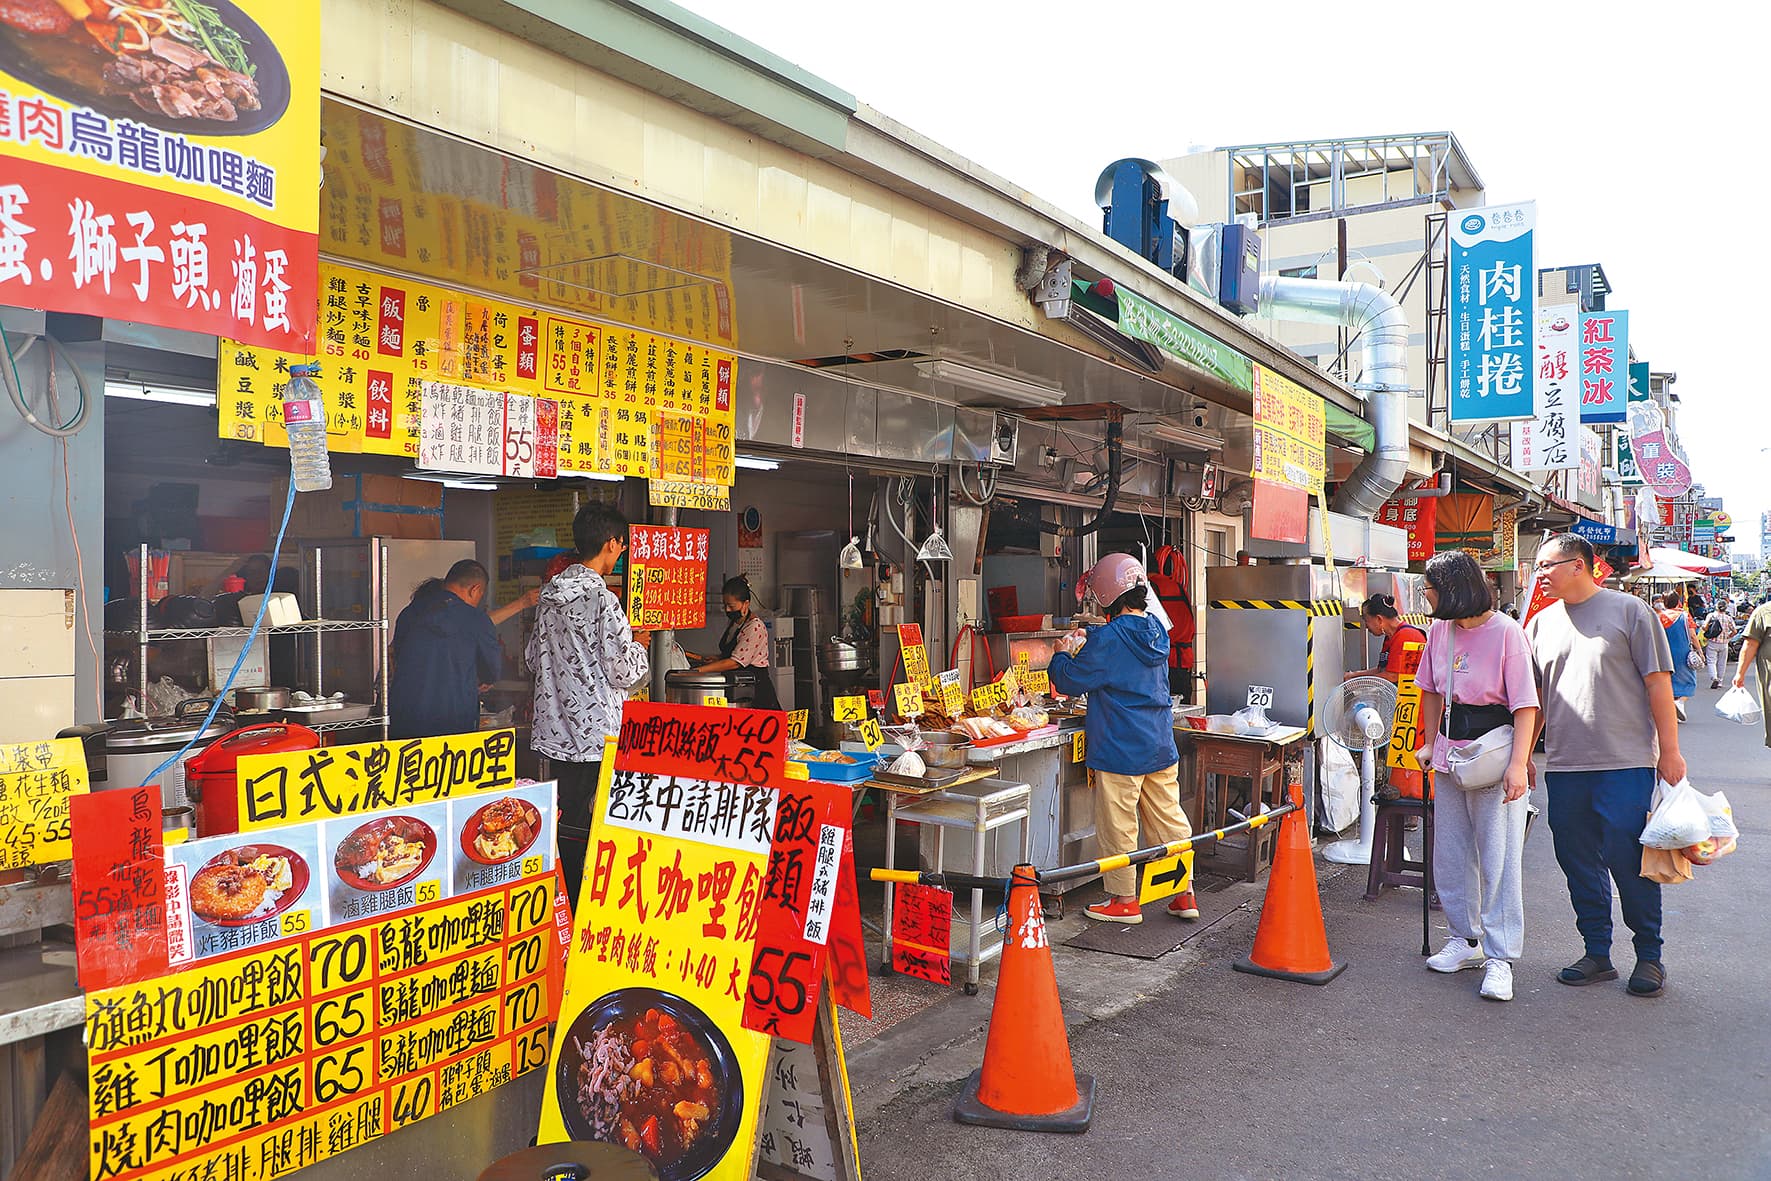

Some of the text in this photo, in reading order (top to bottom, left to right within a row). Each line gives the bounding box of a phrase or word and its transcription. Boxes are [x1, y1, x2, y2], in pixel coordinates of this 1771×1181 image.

[325, 276, 348, 357] 雞腿炒麵 55
[351, 283, 373, 361] 古早味炒麵 40
[380, 296, 403, 350] 飯麵
[412, 295, 430, 370] 魯蛋 15
[1476, 260, 1525, 398] 肉桂捲
[492, 311, 508, 383] 荷包蛋 15
[518, 325, 537, 373] 蛋類
[568, 328, 582, 390] 3個自由配
[584, 348, 595, 374] 特價
[1582, 317, 1615, 405] 紅茶冰
[603, 390, 617, 400] 35
[624, 393, 637, 403] 20
[644, 396, 656, 406] 20
[663, 399, 675, 409] 20
[717, 366, 730, 406] 餅類
[368, 379, 392, 431] 飲料
[681, 402, 693, 412] 20
[699, 405, 710, 415] 20
[506, 427, 532, 463] 55
[579, 403, 592, 470] 香腸 25
[616, 408, 629, 445] 鍋貼
[634, 411, 647, 447] 鍋貼
[717, 424, 730, 440] 70
[559, 458, 572, 468] 25
[616, 464, 628, 473] 30
[638, 466, 645, 475] 6
[718, 444, 730, 460] 70
[1641, 443, 1676, 479] 童裝
[717, 465, 729, 480] 70
[633, 529, 708, 561] 滿額送豆漿
[631, 567, 644, 623] 消費
[902, 695, 919, 713] 35
[993, 682, 1008, 703] 55
[1250, 693, 1269, 706] 20
[842, 707, 859, 720] 25
[618, 714, 720, 764] 咖哩肉絲飯
[863, 720, 880, 746] 30
[247, 731, 515, 822] 日式濃厚咖哩
[463, 858, 540, 889] 炸腿排飯 55
[343, 883, 437, 918] 滷雞腿飯 55
[199, 912, 307, 954] 炸豬排飯 55
[379, 884, 548, 971] 烏龍咖哩麵 70
[88, 934, 366, 1050] 旗魚丸咖哩飯 70
[377, 934, 542, 1030] 烏龍咖哩麵 70
[505, 982, 540, 1030] 70
[92, 992, 364, 1118] 雞丁咖哩飯 65
[517, 1026, 546, 1074] 15
[94, 1046, 364, 1179] 燒肉咖哩飯 65
[393, 1077, 432, 1126] 40
